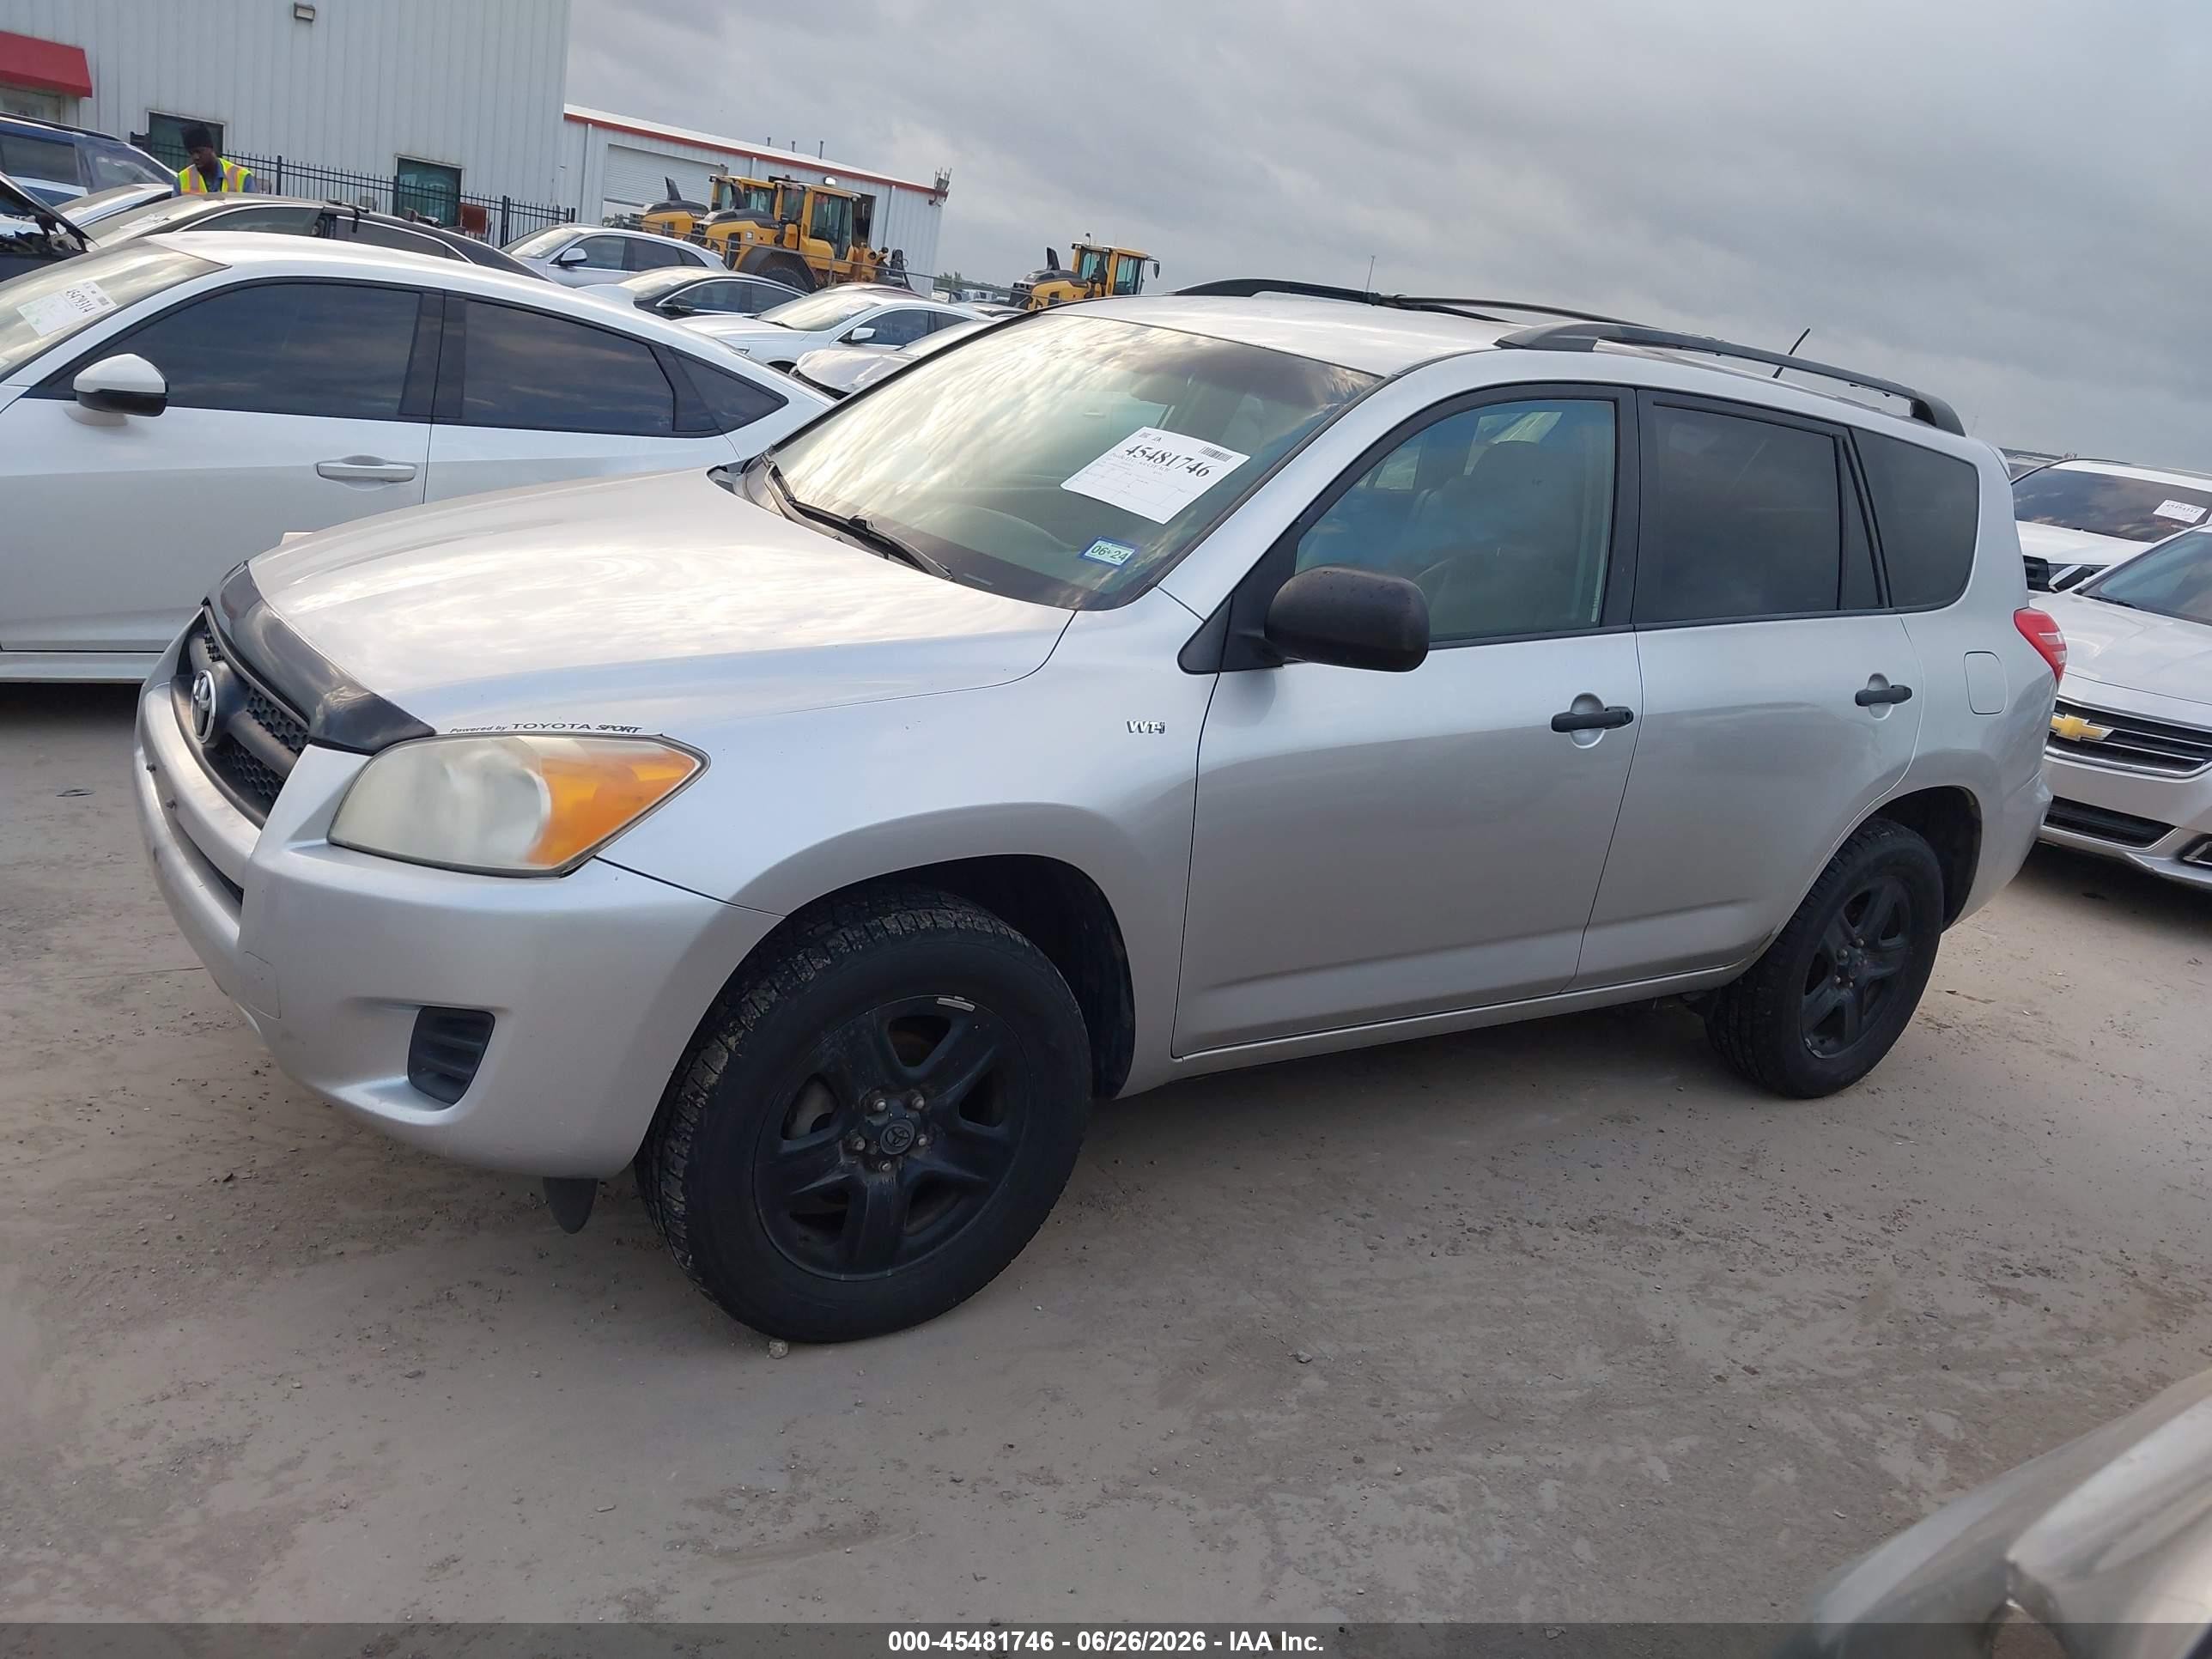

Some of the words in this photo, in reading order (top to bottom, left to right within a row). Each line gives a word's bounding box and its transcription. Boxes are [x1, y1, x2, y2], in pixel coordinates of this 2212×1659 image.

[1125, 445, 1218, 477] 45481746
[1091, 545, 1109, 556] 06
[1109, 550, 1129, 561] 24
[596, 724, 642, 733] SPORT
